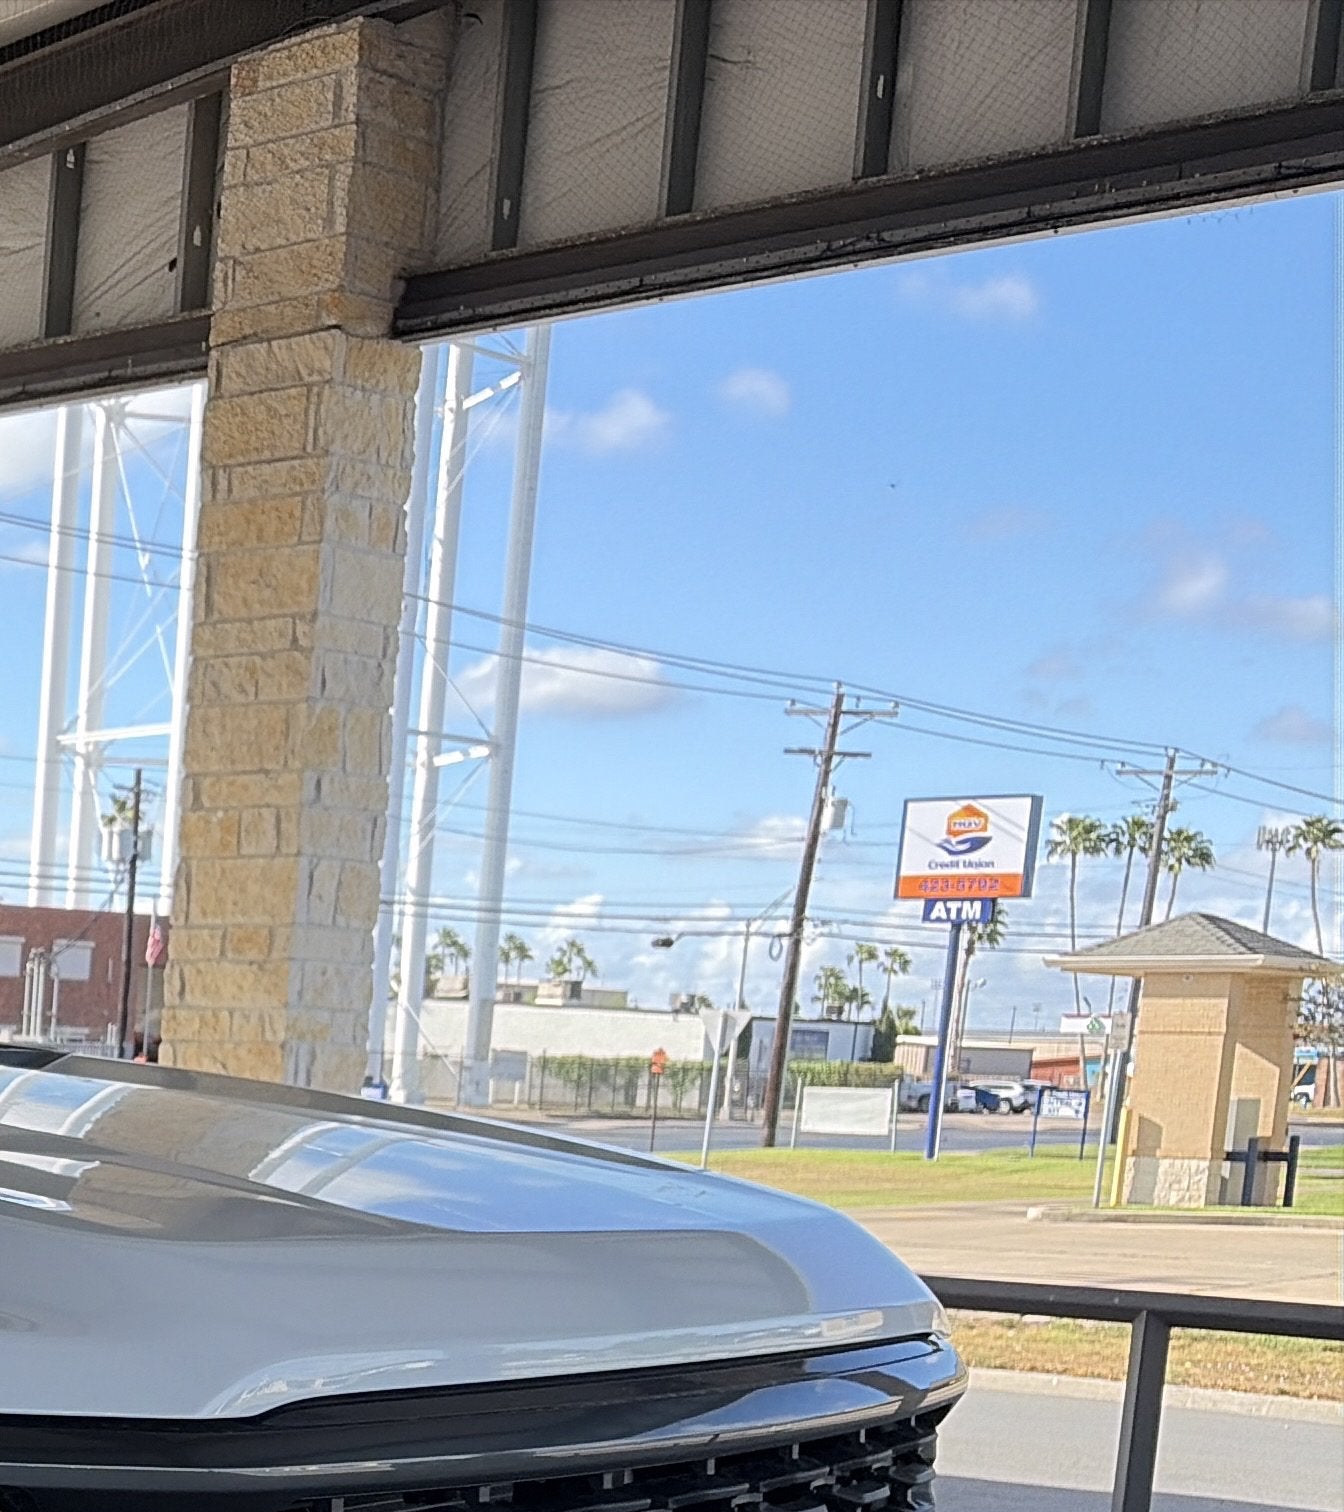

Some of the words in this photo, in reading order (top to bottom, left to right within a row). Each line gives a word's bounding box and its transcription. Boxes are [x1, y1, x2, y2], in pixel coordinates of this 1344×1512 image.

[928, 858, 960, 870] Credit
[963, 858, 995, 870] Union
[929, 901, 982, 920] ATM
